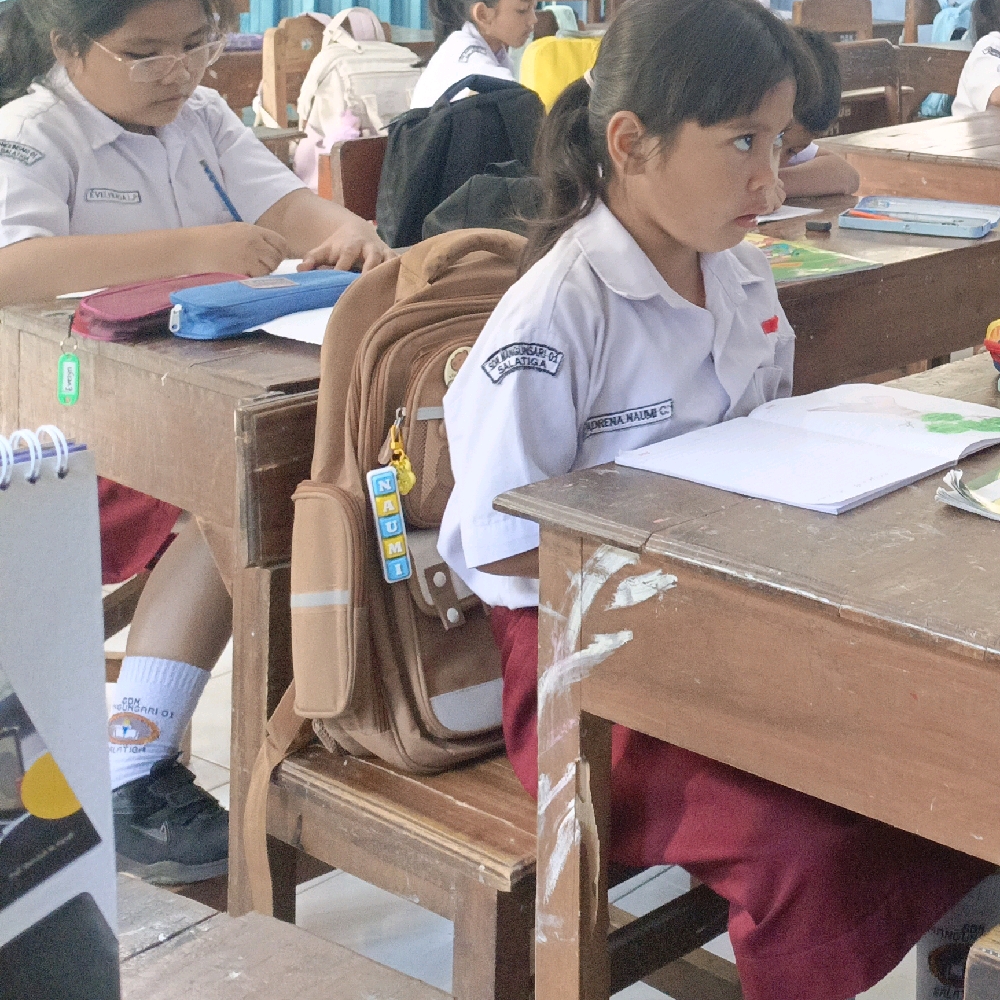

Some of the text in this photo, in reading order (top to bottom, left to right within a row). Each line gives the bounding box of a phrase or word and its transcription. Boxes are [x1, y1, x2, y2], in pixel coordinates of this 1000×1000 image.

[498, 356, 546, 374] SALATIGA
[626, 408, 657, 422] NAUMI
[377, 478, 403, 576] NAUMI
